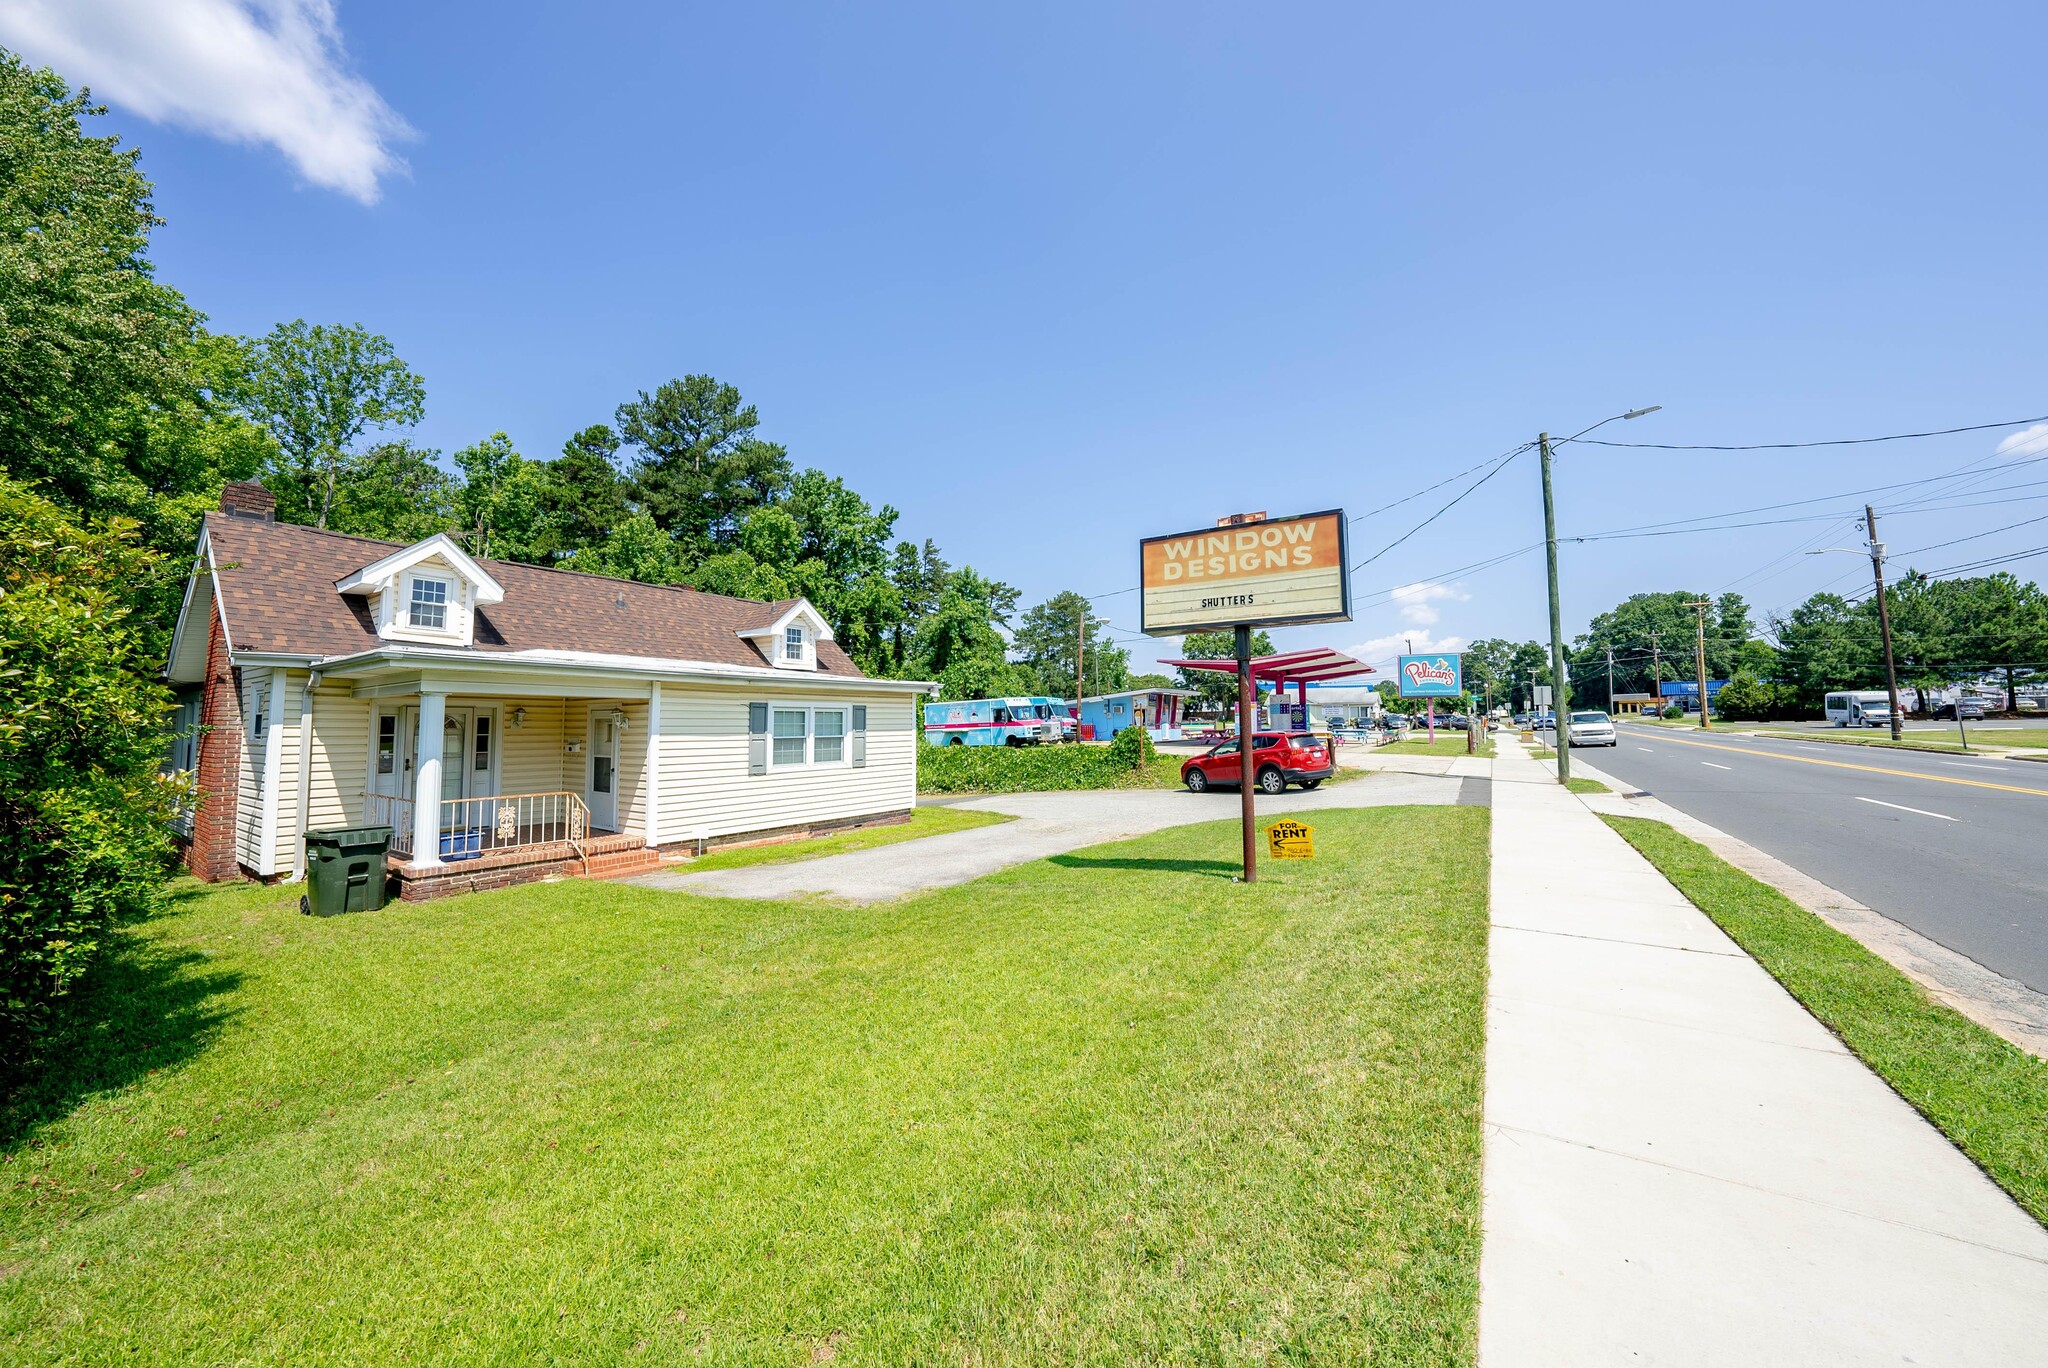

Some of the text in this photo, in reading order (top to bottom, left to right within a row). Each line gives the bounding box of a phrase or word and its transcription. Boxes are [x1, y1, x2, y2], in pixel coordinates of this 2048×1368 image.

[1163, 522, 1316, 560] WINDOW
[1164, 546, 1313, 580] DESIGNS
[1201, 594, 1254, 608] SHUTTERS
[1405, 662, 1455, 686] Pelican's
[1273, 829, 1307, 838] RENT
